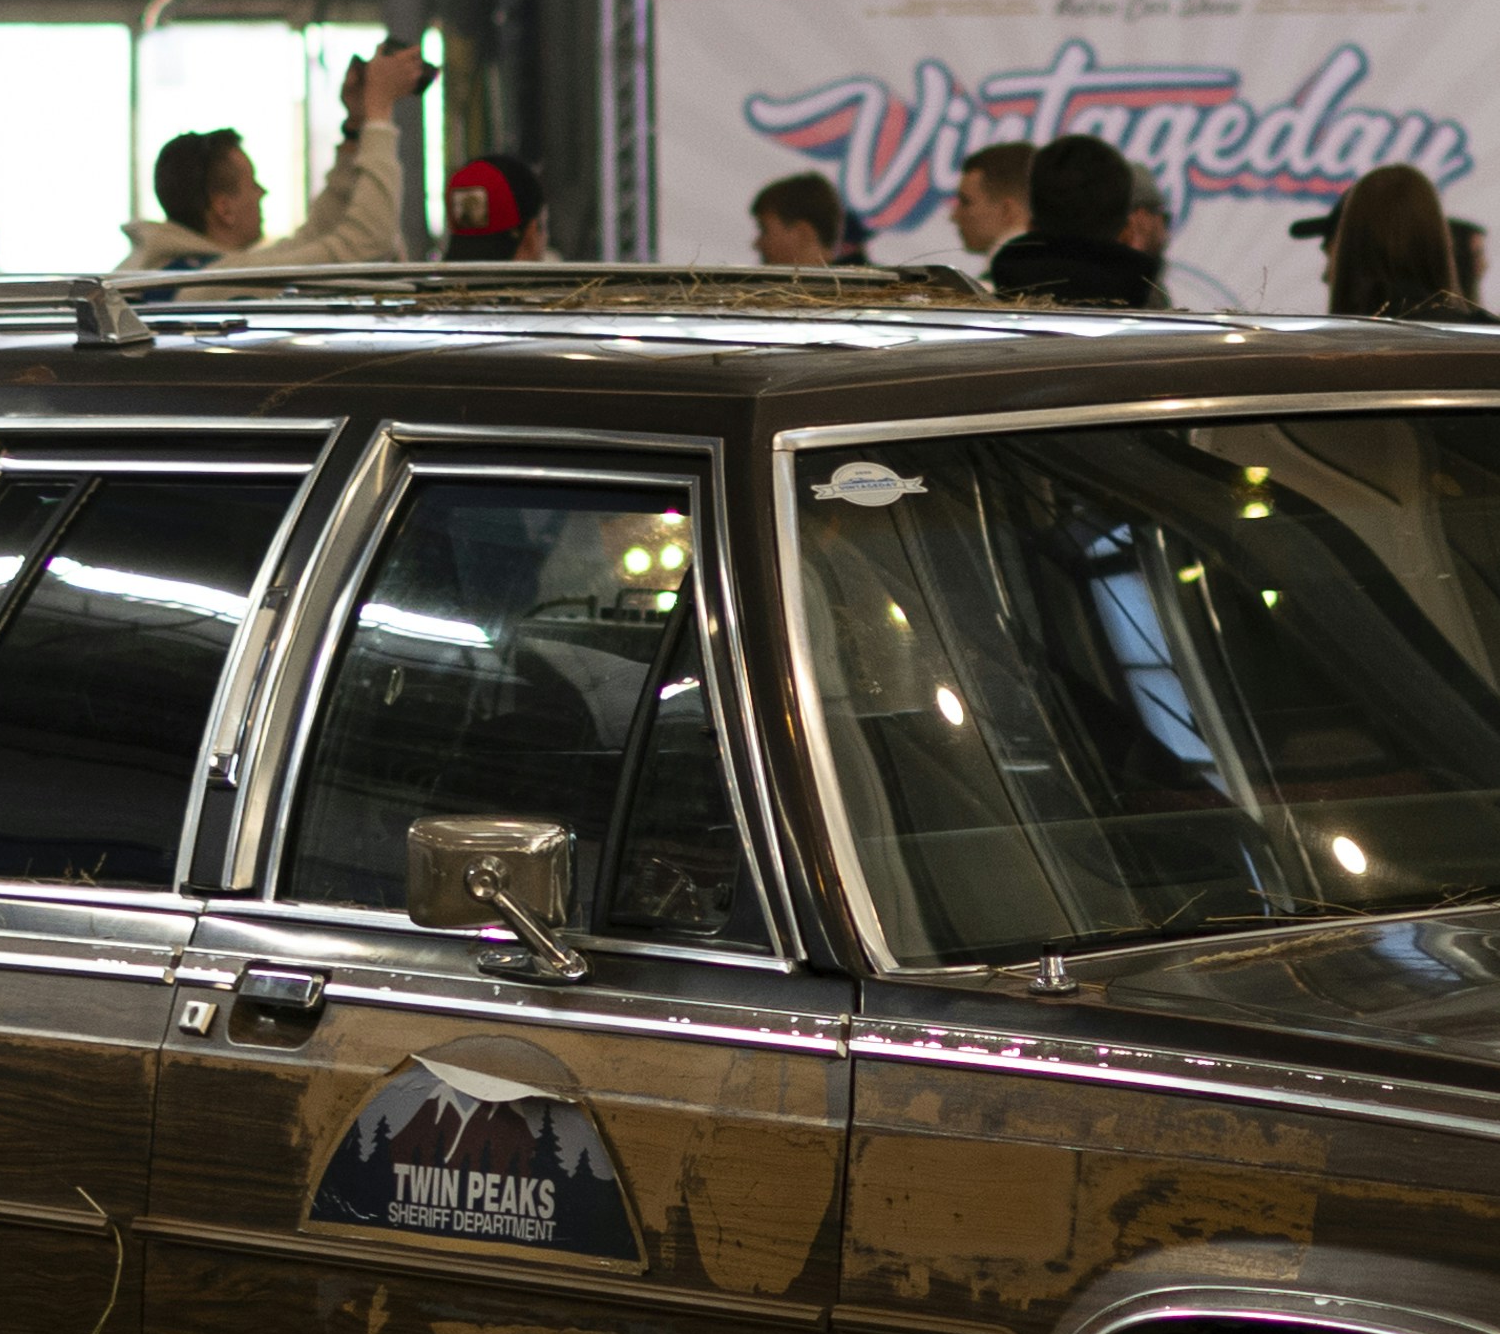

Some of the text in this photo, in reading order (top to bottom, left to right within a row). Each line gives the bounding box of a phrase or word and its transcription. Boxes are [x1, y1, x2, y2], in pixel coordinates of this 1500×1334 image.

[744, 38, 1476, 232] Vintageday
[392, 1162, 556, 1219] TWIN PEAKS
[387, 1201, 557, 1242] SHERIFF DEPARTMENT
